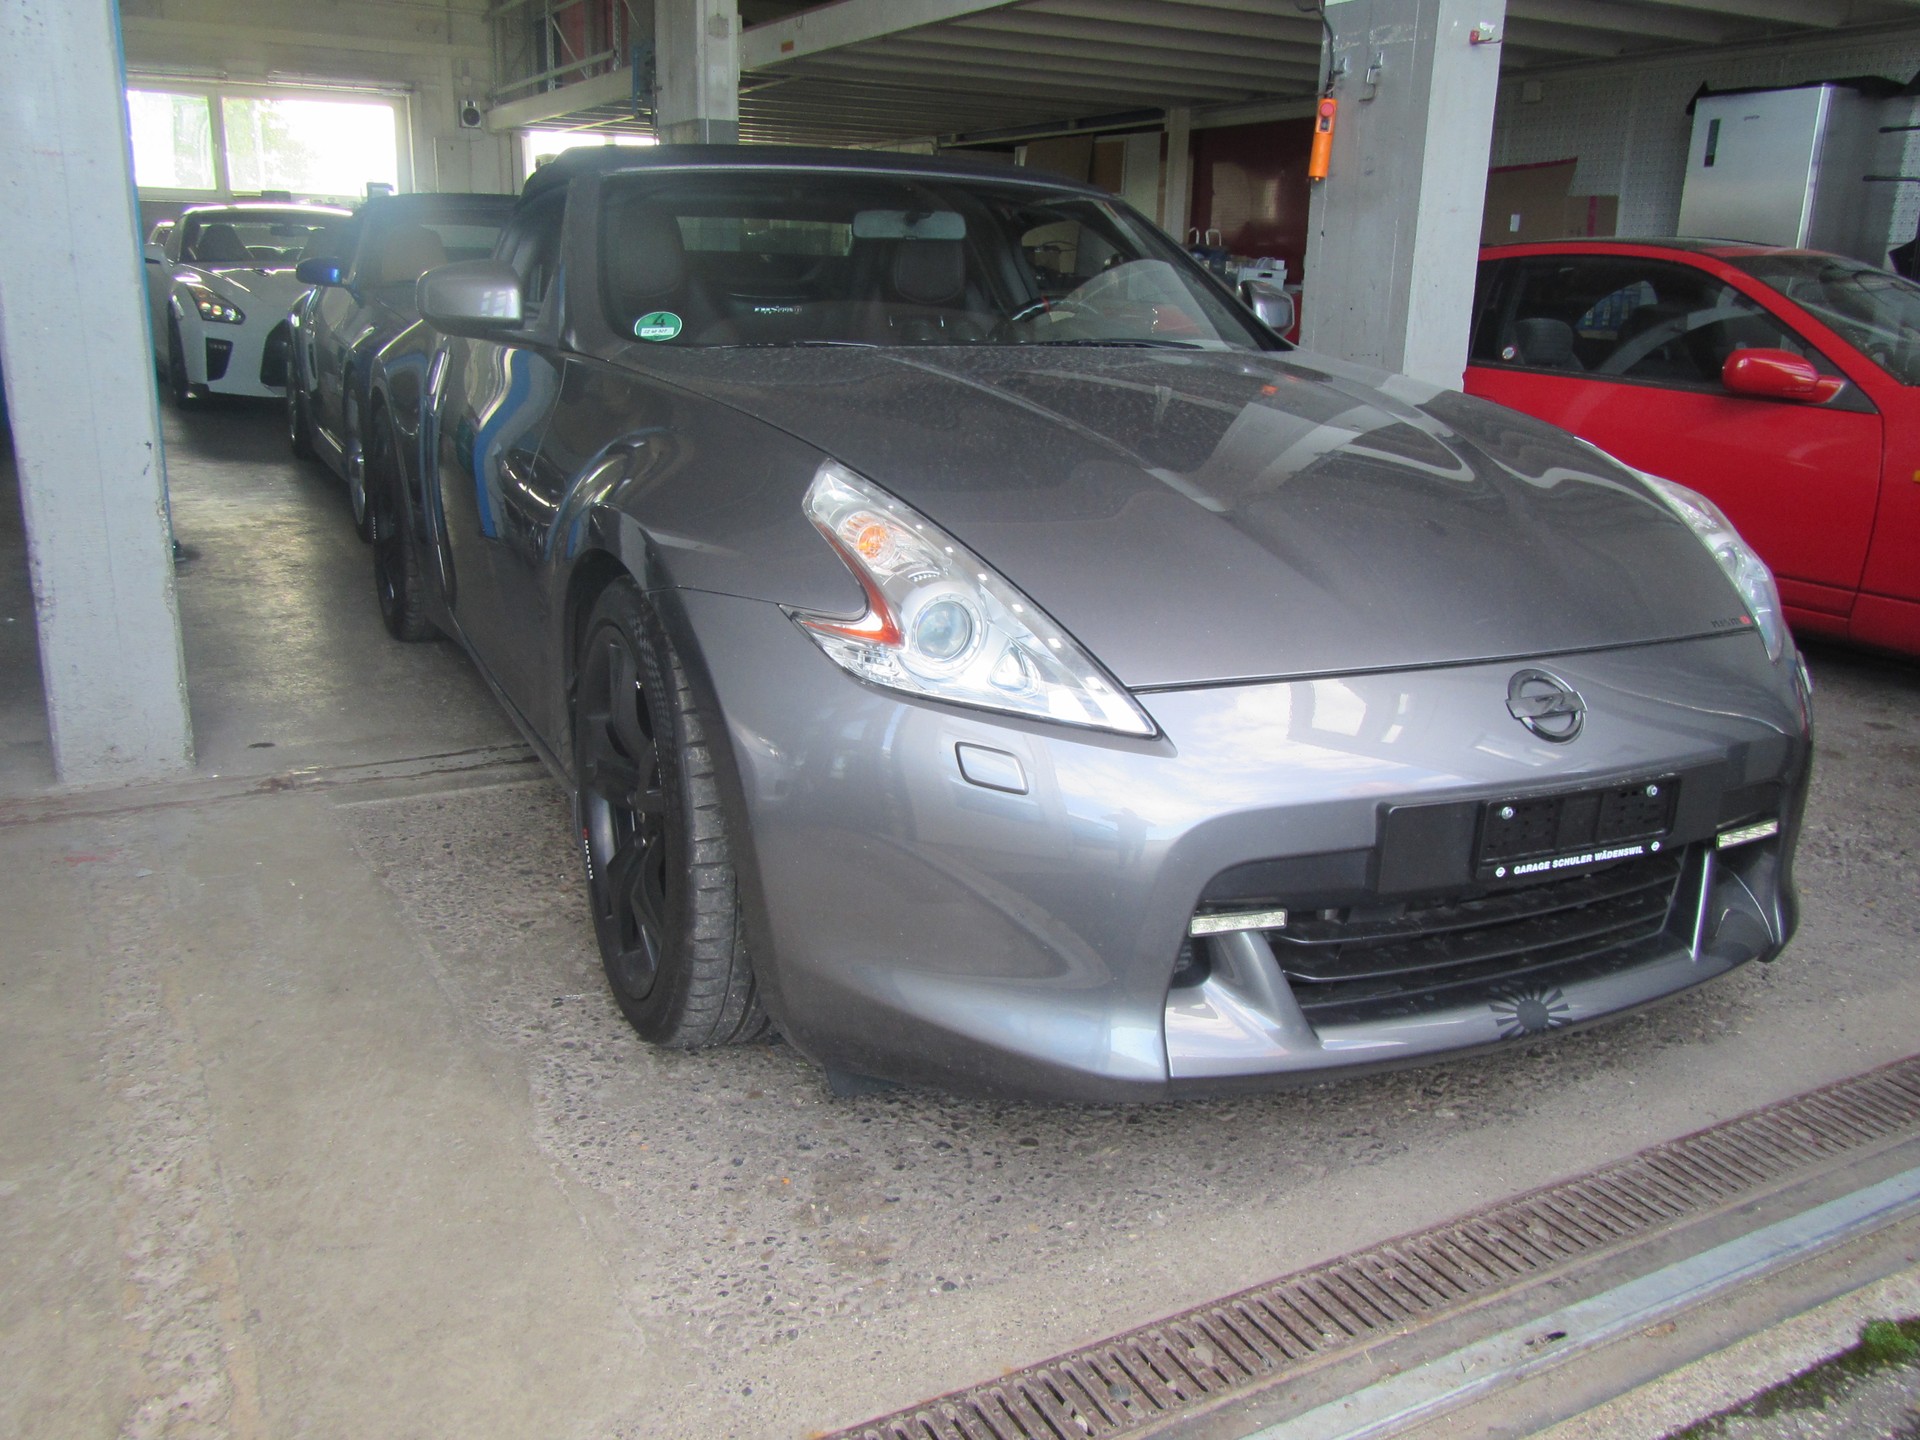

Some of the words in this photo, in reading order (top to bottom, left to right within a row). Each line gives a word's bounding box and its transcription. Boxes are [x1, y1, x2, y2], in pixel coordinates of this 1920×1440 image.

[653, 313, 666, 328] 4
[1513, 860, 1551, 875] GARAGE
[1552, 852, 1593, 869] SCHULER
[1594, 845, 1644, 861] WÄDENSWIL
